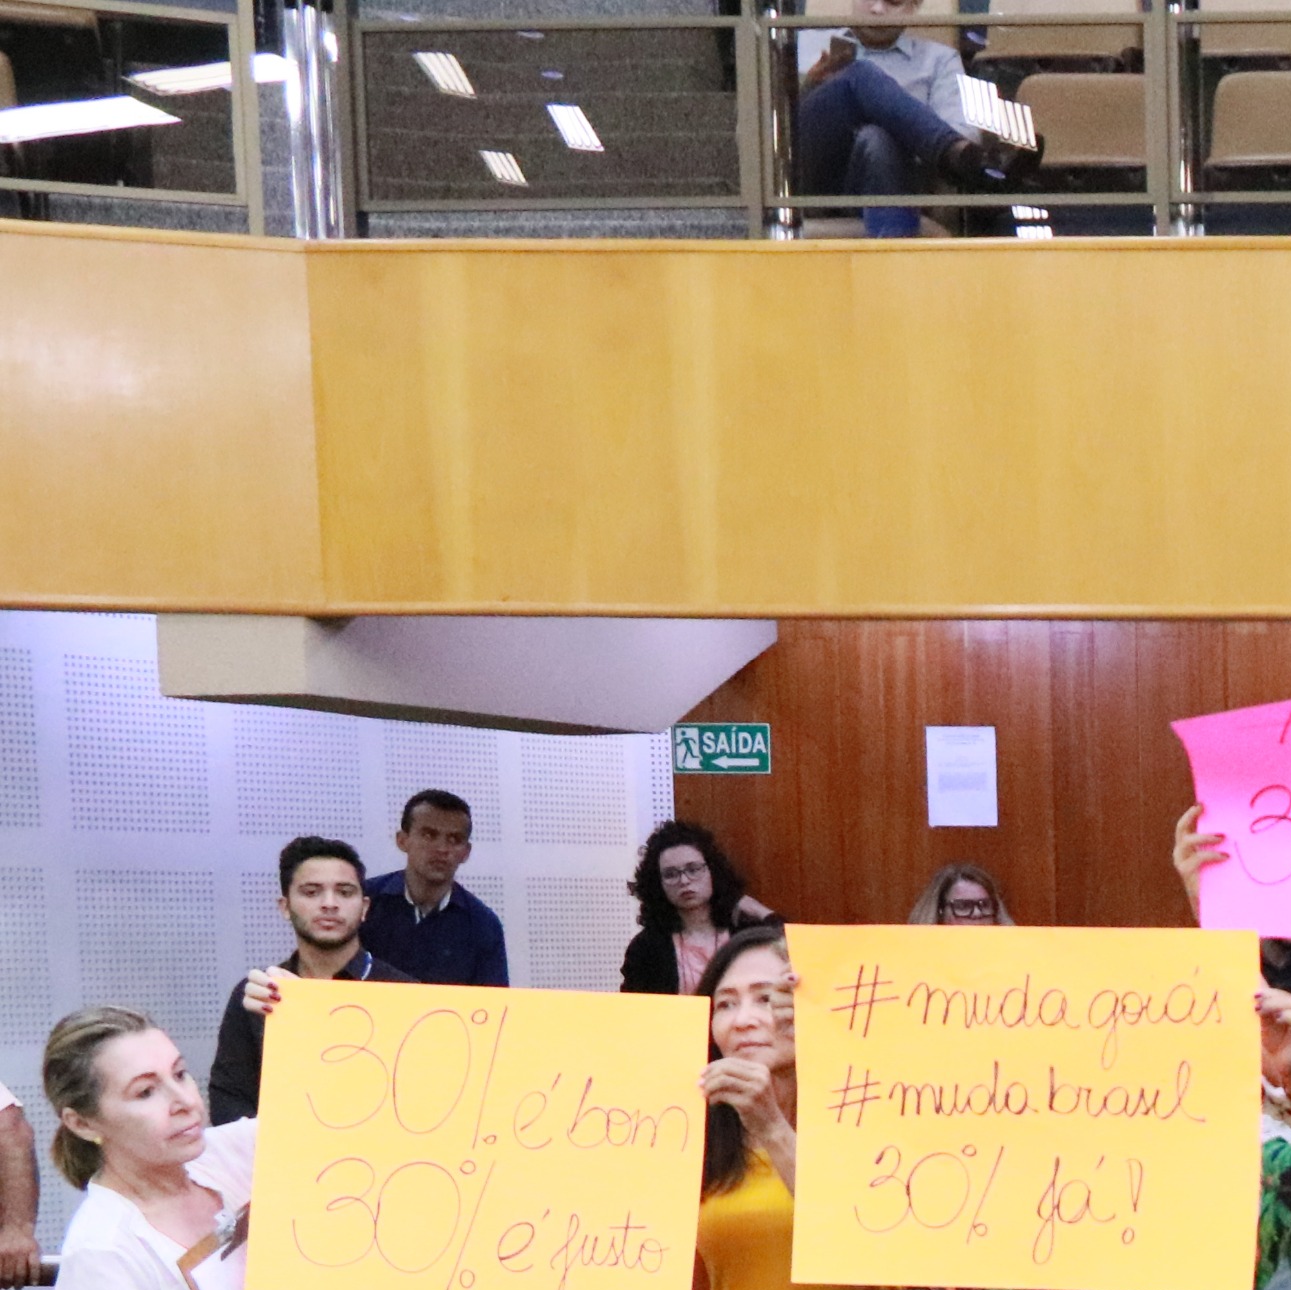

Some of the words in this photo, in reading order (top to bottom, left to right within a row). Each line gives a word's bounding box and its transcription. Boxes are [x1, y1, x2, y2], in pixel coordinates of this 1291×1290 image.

[702, 727, 767, 754] SAÍDA
[306, 1004, 508, 1149] 30%
[513, 1073, 562, 1150] é
[567, 1076, 689, 1152] bom
[854, 1144, 1005, 1245] 30%
[497, 1208, 550, 1273] é
